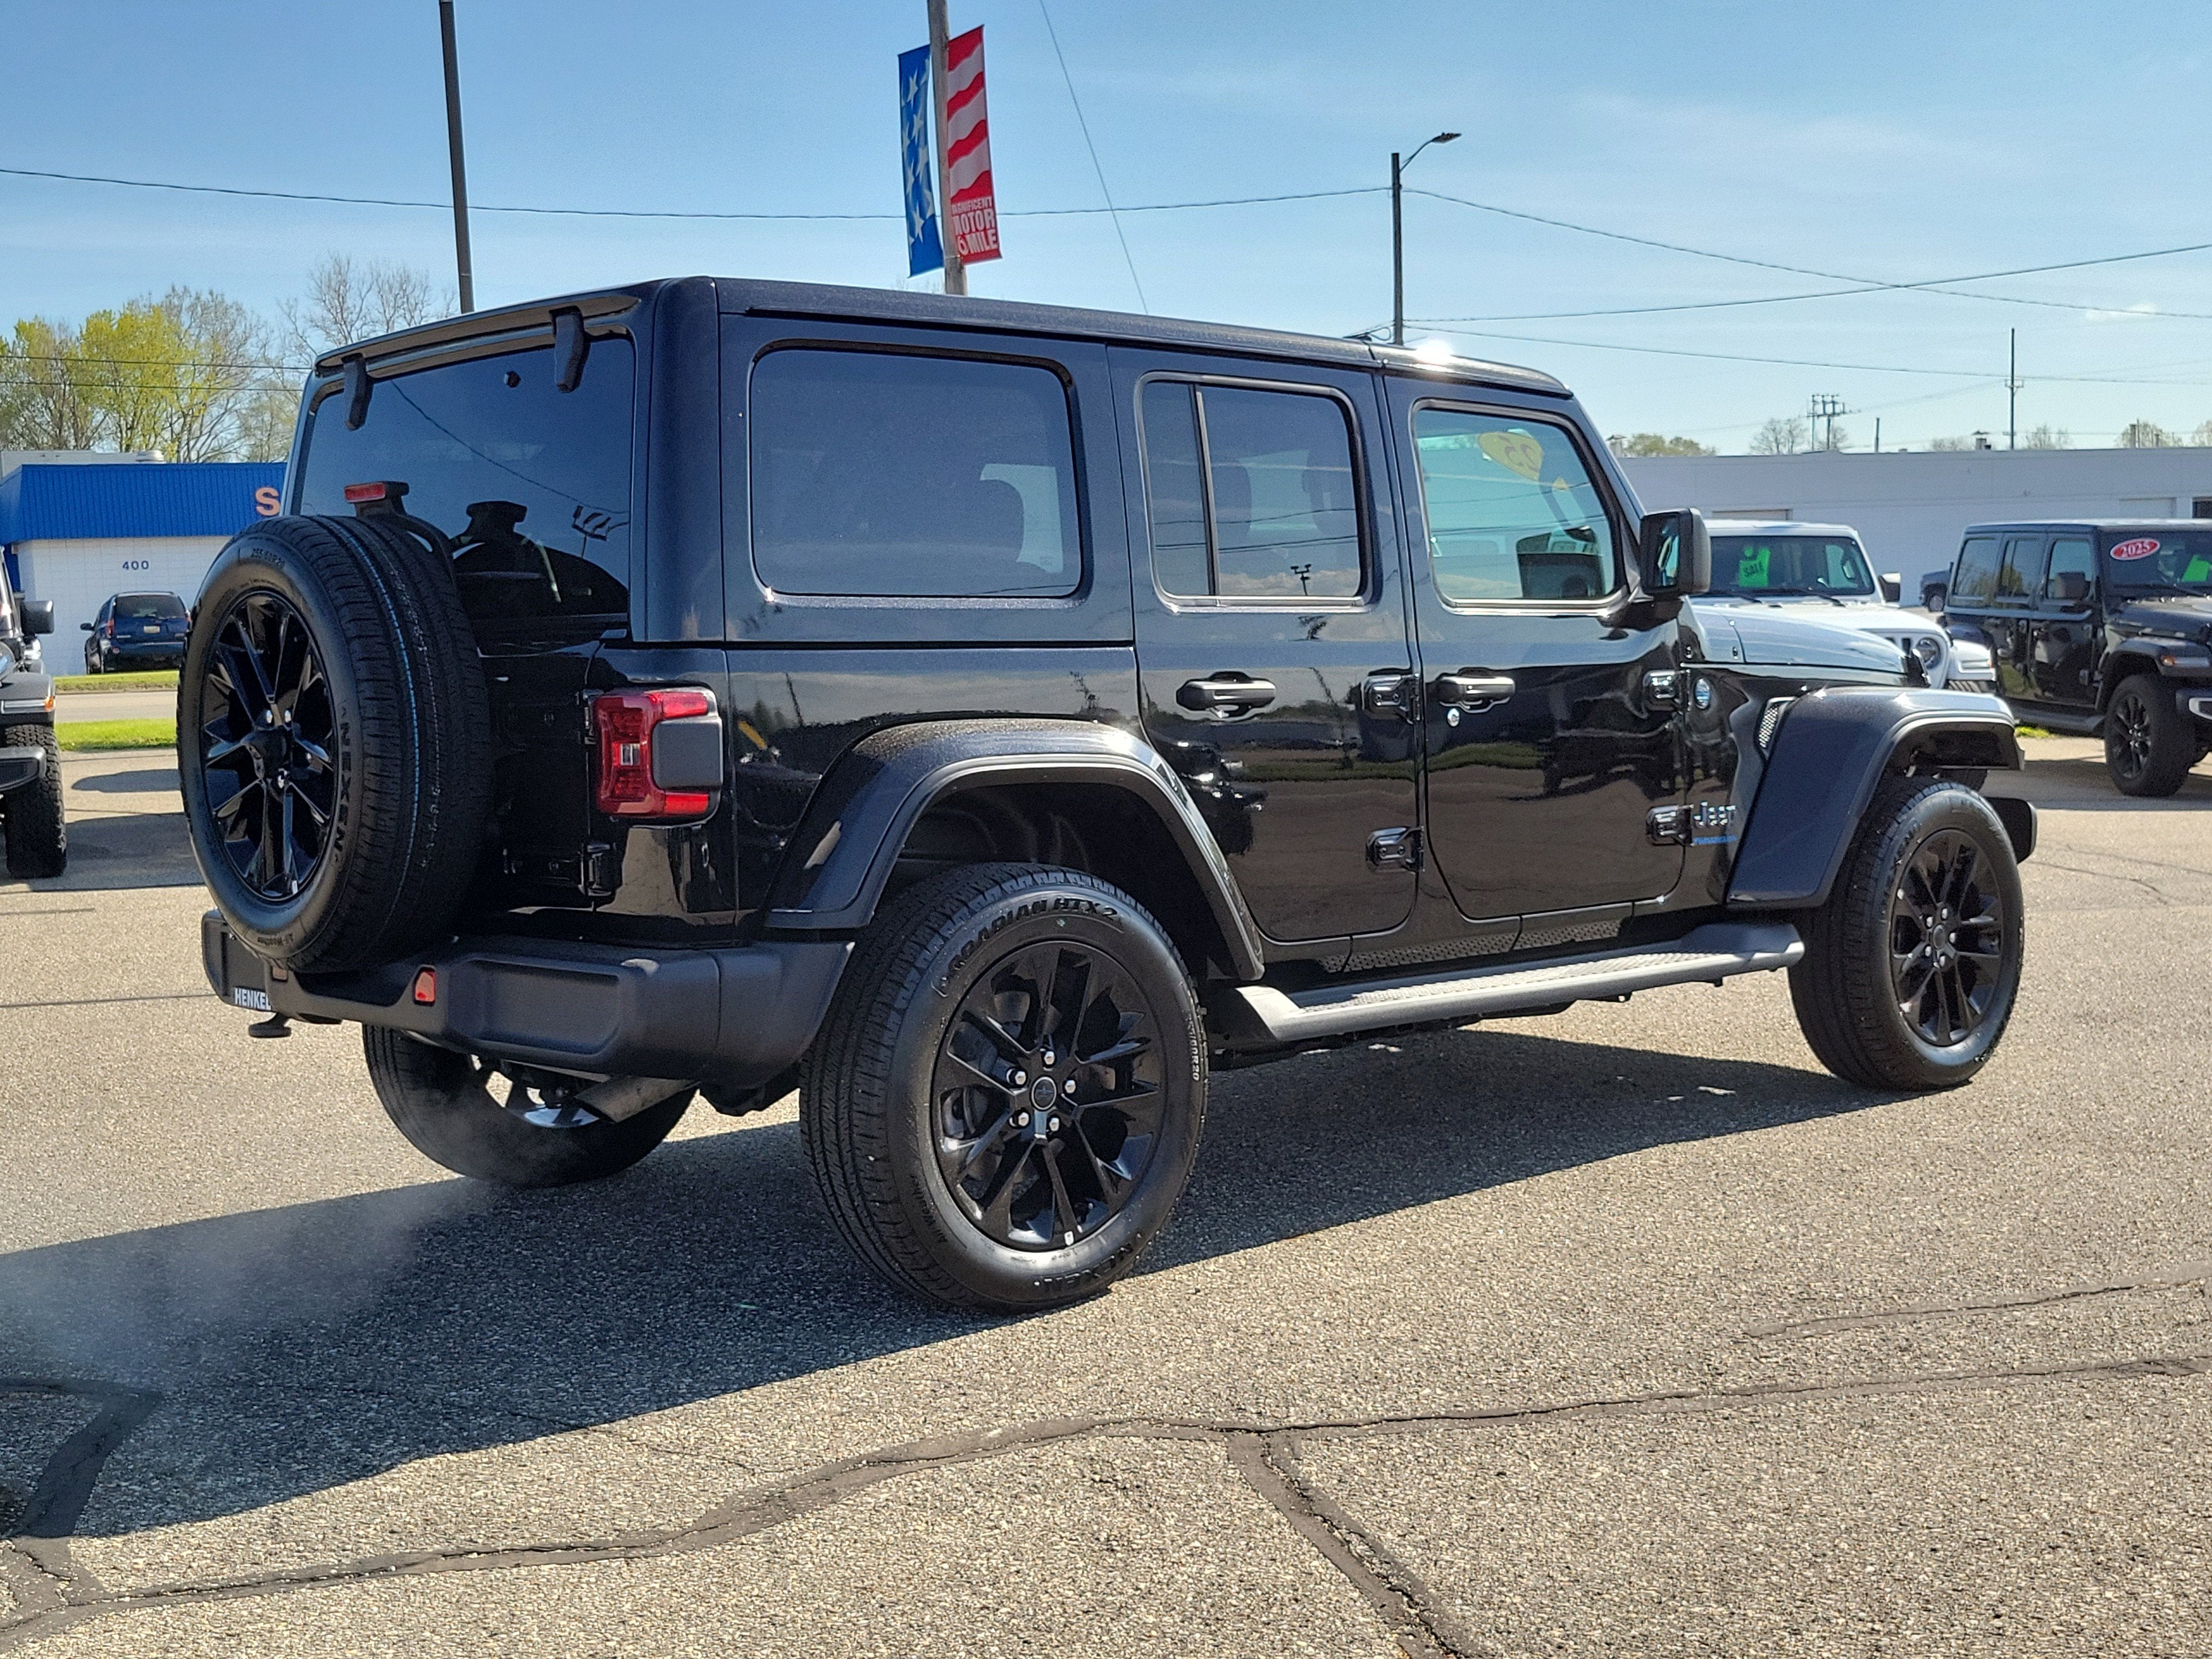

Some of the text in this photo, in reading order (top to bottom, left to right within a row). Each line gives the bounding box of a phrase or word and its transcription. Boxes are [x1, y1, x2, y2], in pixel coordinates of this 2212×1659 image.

[953, 209, 995, 235] MOTOR
[966, 229, 998, 254] MILE
[256, 487, 280, 516] S
[2121, 540, 2151, 558] 2025
[122, 560, 149, 570] 400
[1694, 802, 1736, 828] Jeep
